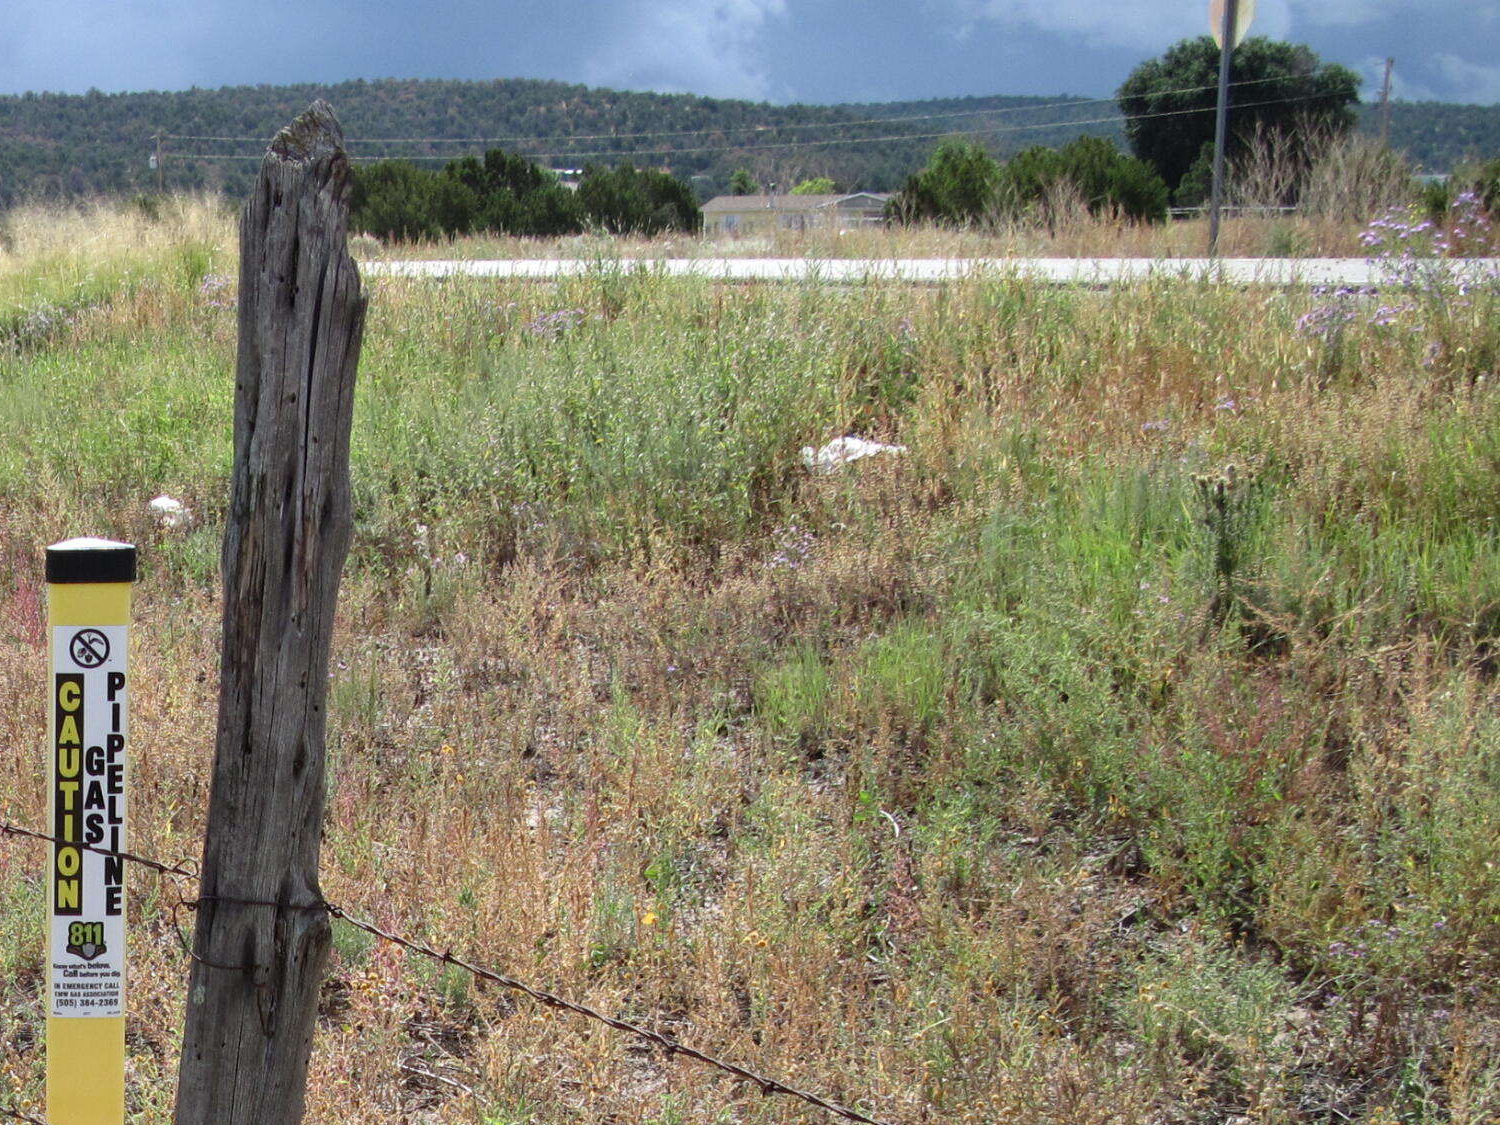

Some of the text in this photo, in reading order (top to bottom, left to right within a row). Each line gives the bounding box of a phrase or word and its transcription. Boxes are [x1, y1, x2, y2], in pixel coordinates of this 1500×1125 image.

[58, 681, 80, 908] CAUTION
[84, 746, 105, 844] GAS
[104, 672, 125, 916] PIPELINE
[69, 921, 104, 946] 811
[56, 999, 77, 1008] (505)
